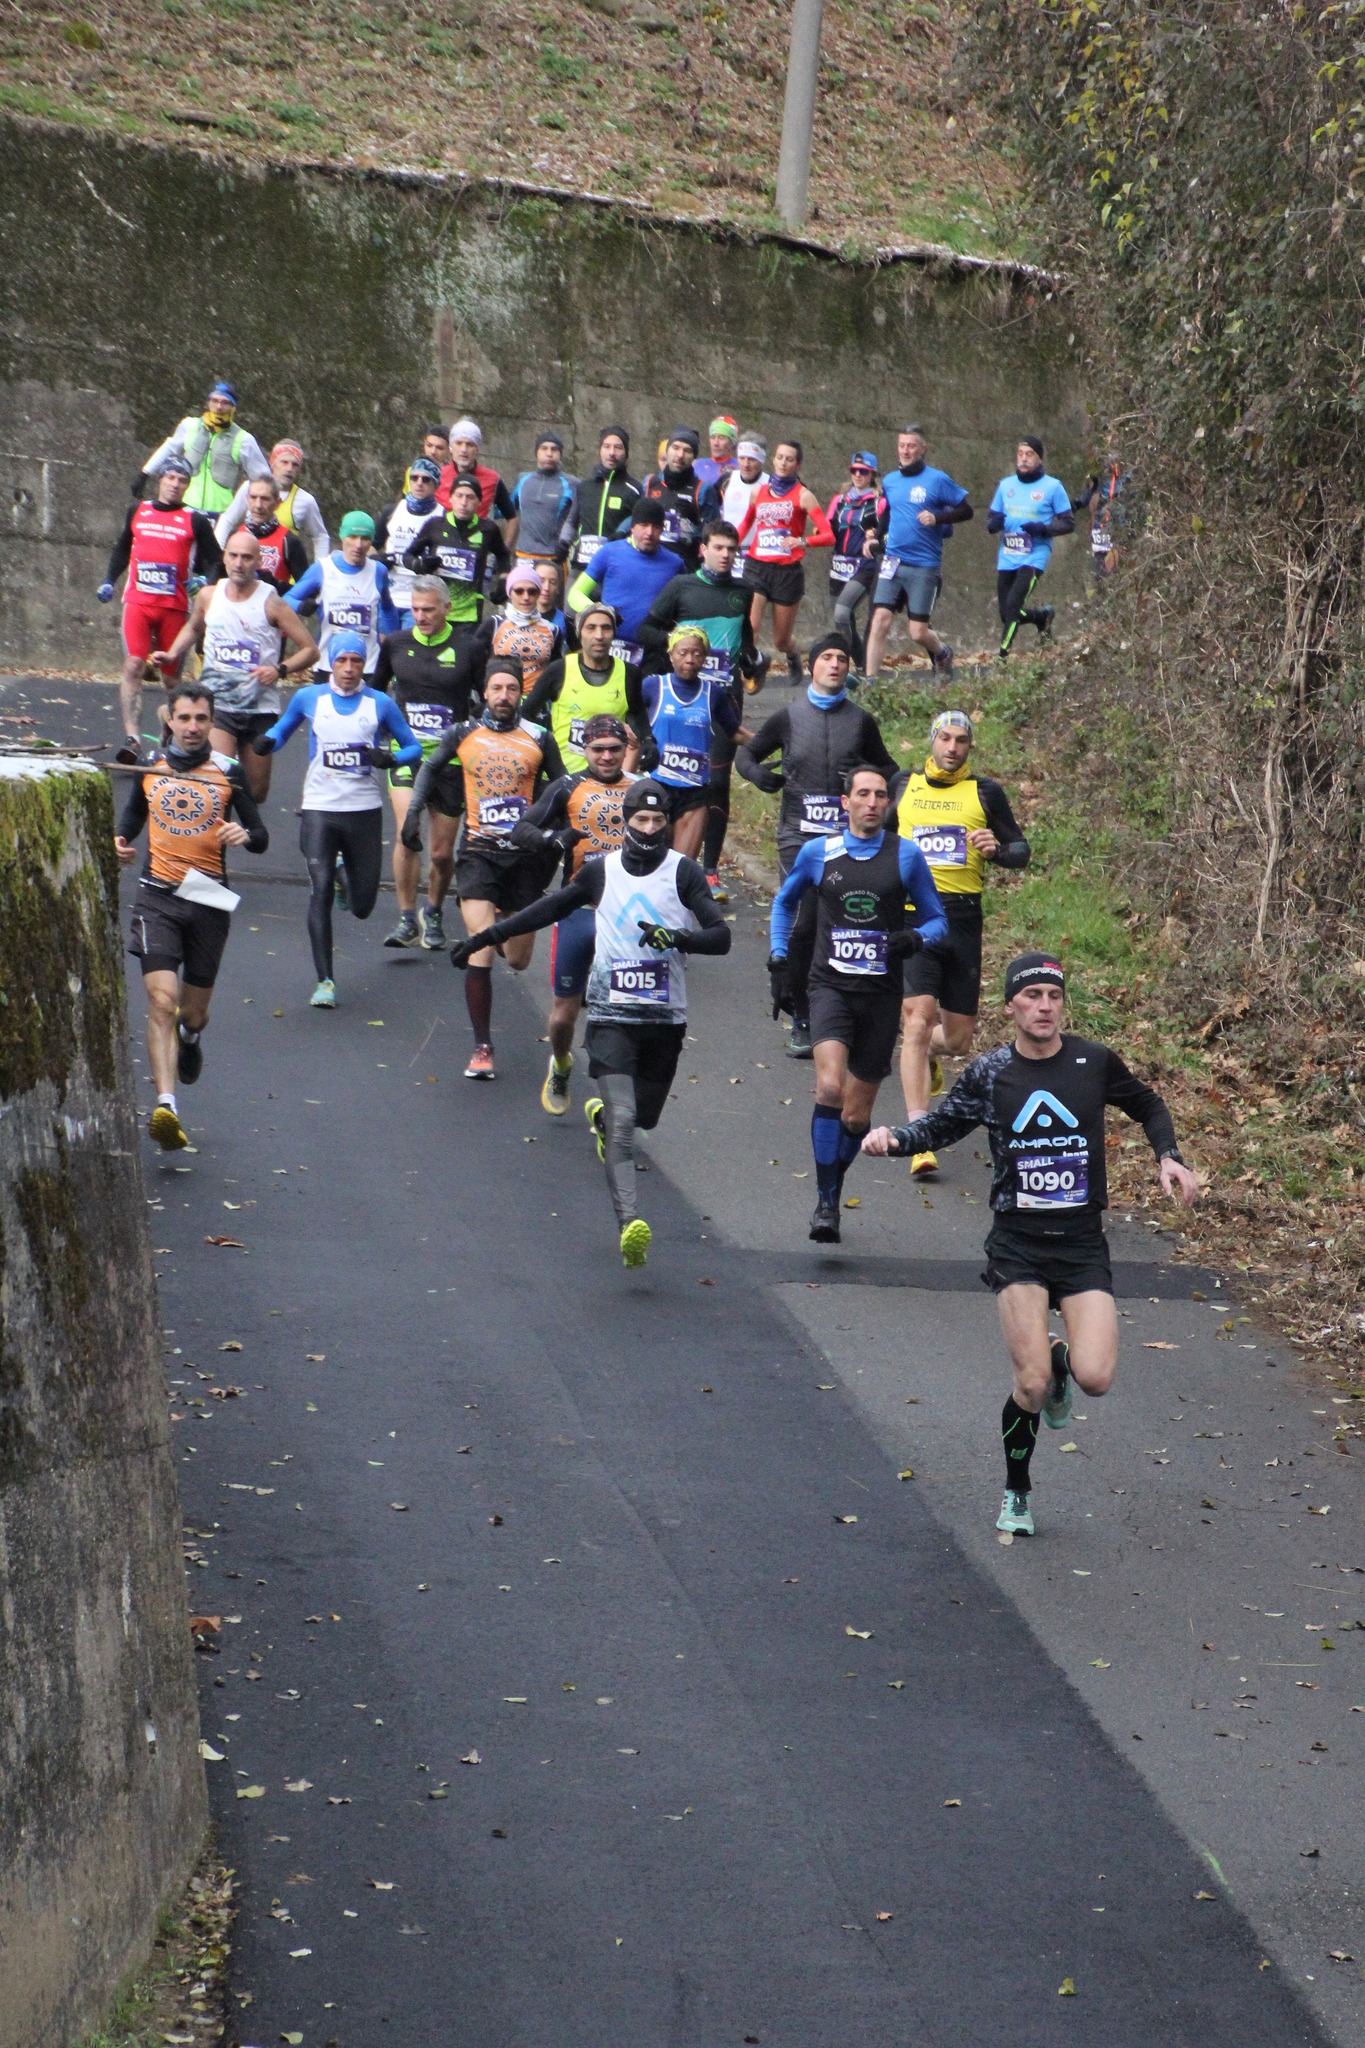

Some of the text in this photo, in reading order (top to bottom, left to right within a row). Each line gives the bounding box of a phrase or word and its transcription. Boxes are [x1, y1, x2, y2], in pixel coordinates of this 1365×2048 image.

[581, 542, 603, 554] 109
[1006, 537, 1025, 547] 1012
[438, 555, 467, 569] 035
[832, 560, 854, 574] 1080
[138, 569, 169, 584] 1083
[331, 611, 362, 625] 1061
[215, 646, 252, 662] 1048
[702, 655, 719, 669] 31
[406, 703, 430, 712] SMALL
[408, 712, 442, 728] 1052
[571, 728, 584, 743] 10
[323, 743, 349, 752] SMALL
[664, 744, 689, 754] SMALL
[326, 751, 360, 766] 1051
[663, 752, 699, 773] 1040
[480, 798, 505, 809] SMALL
[579, 793, 601, 821] Team
[803, 796, 828, 805] SMALL
[913, 799, 941, 810] ATLETICA
[480, 807, 520, 823] 1043
[913, 826, 940, 838] SMALL
[840, 890, 880, 902] CAMBIASO RISSO
[832, 930, 861, 940] SMALL
[833, 941, 877, 960] 1076
[612, 960, 642, 970] SMALL
[616, 971, 656, 989] 1015
[1017, 1157, 1055, 1170] SMALL
[1019, 1170, 1075, 1191] 1090
